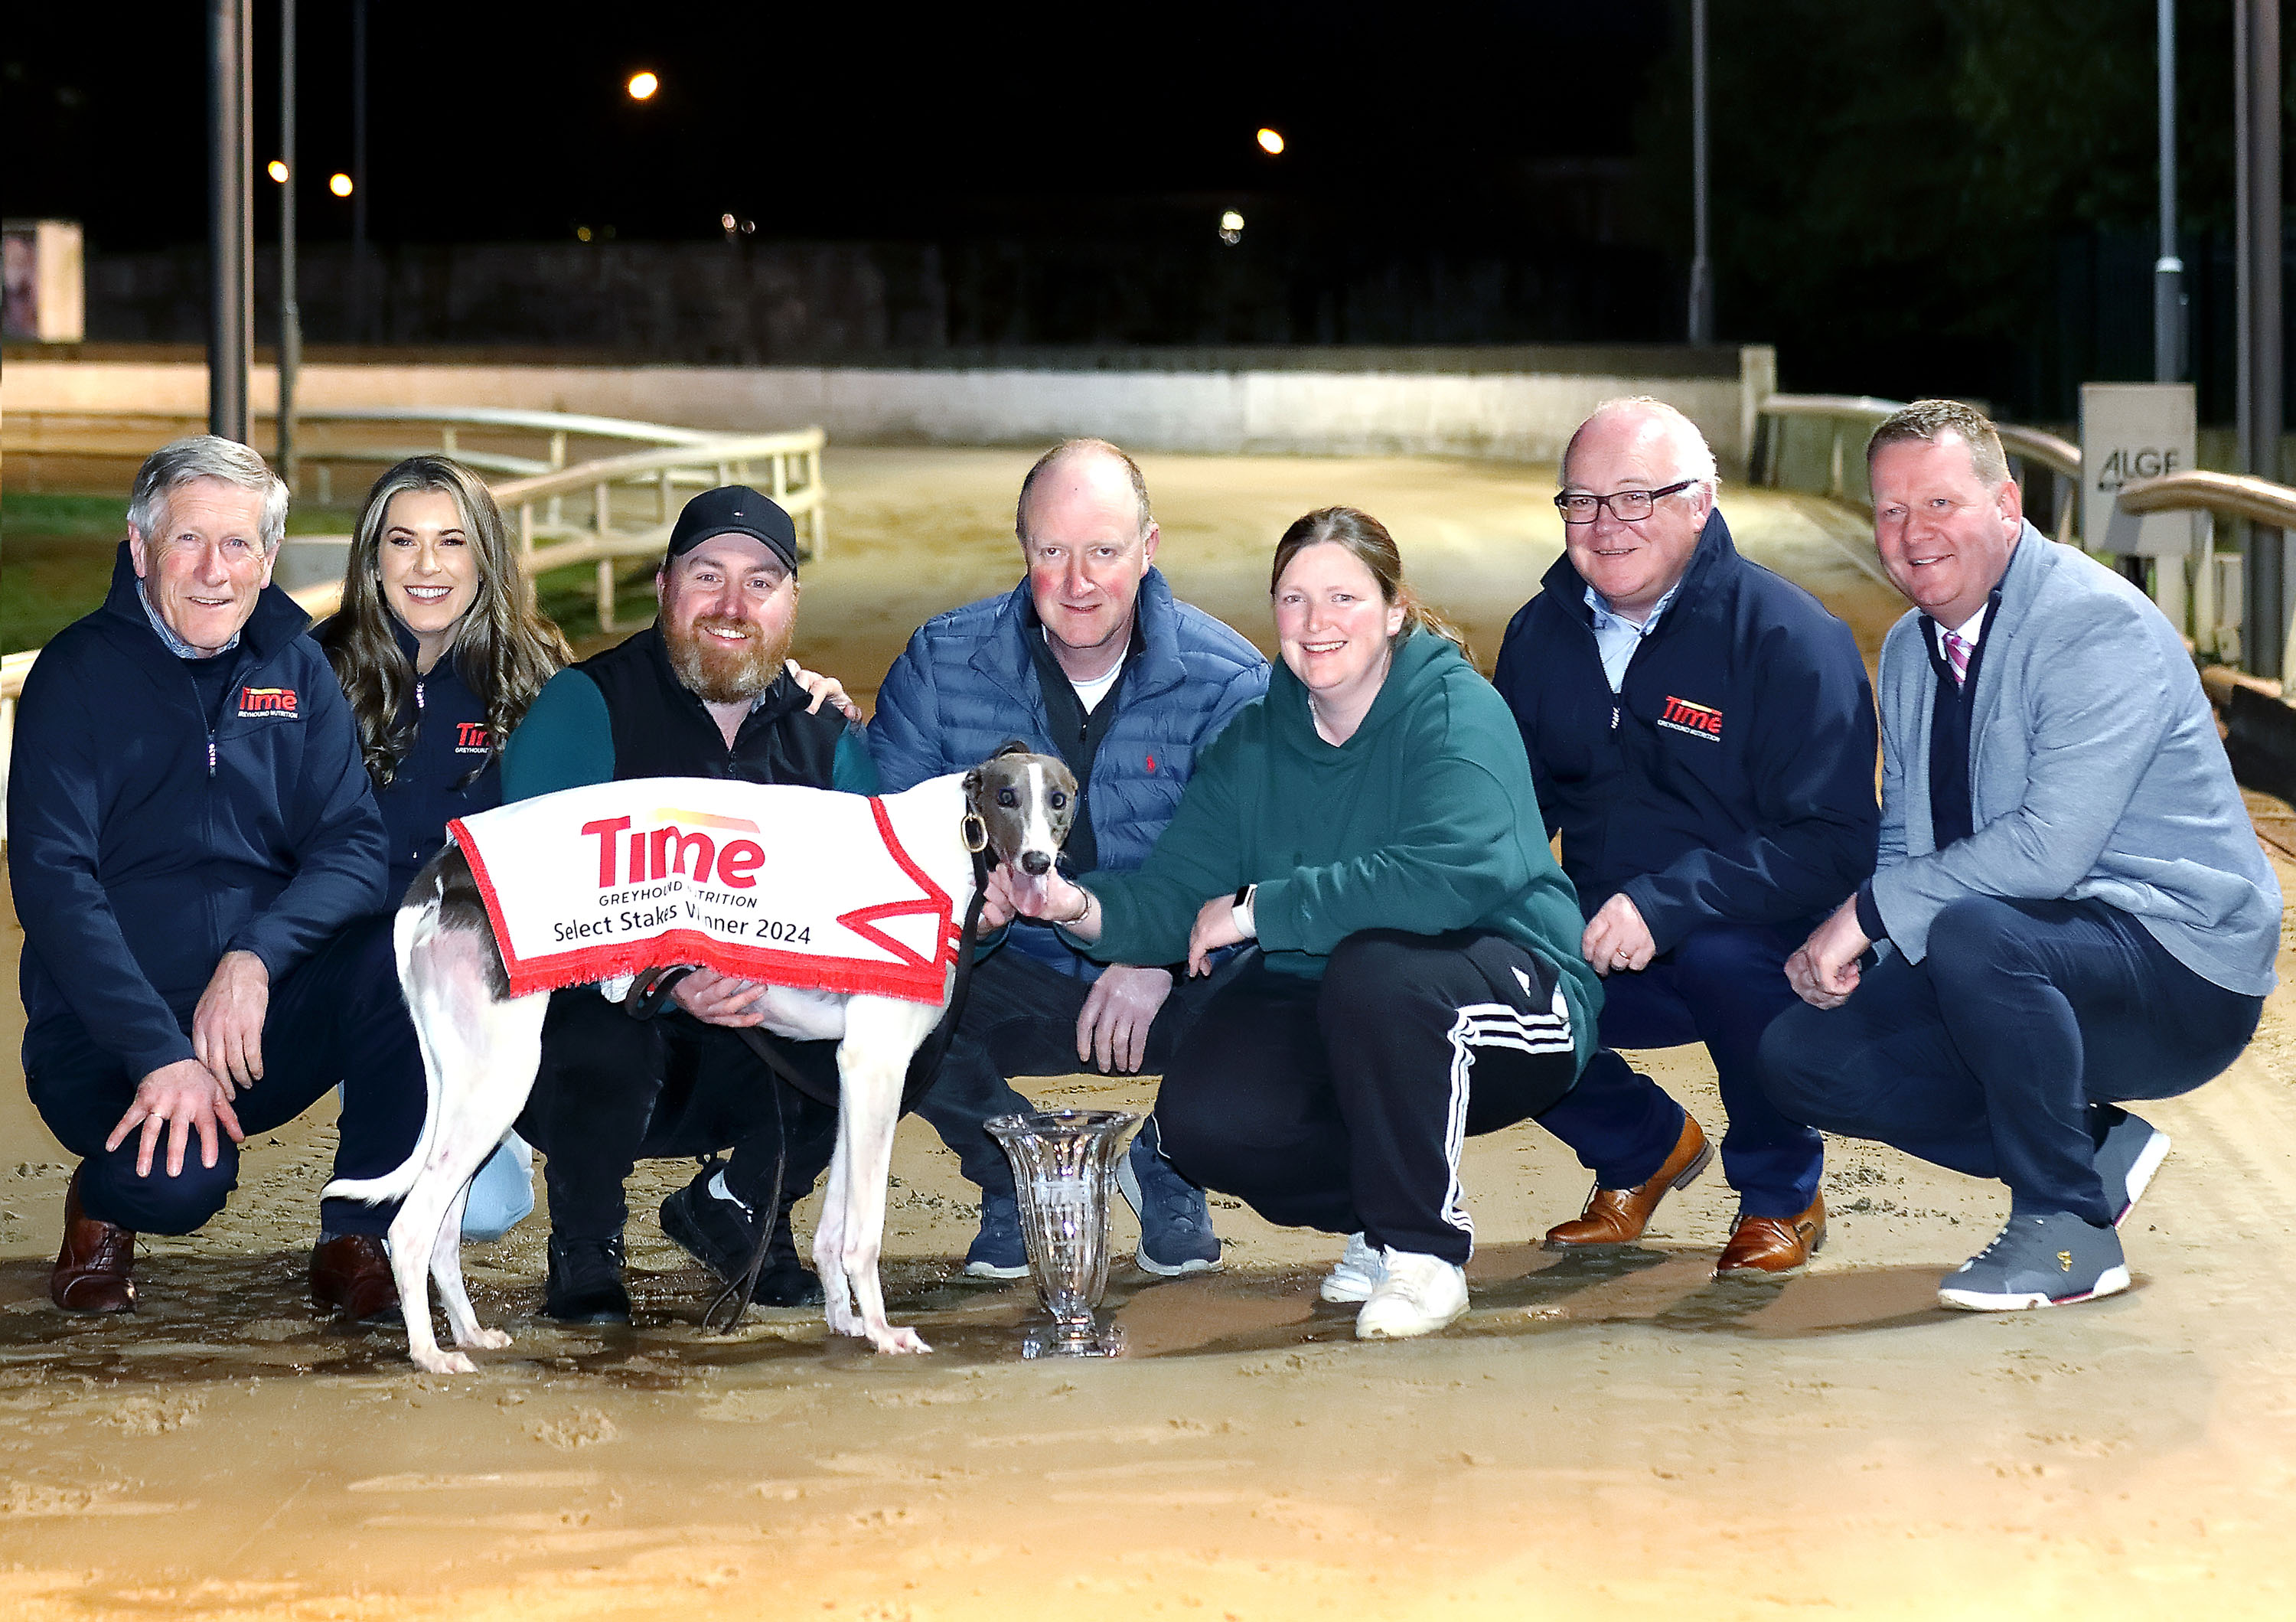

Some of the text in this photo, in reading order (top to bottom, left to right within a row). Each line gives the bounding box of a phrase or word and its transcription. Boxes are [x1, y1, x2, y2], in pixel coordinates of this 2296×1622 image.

[240, 687, 297, 710] Time
[1663, 695, 1723, 733] Time
[581, 815, 765, 889] Time
[599, 881, 757, 909] GREYHOUND TRITION
[554, 901, 811, 945] Select Stakes Wnner 2024
